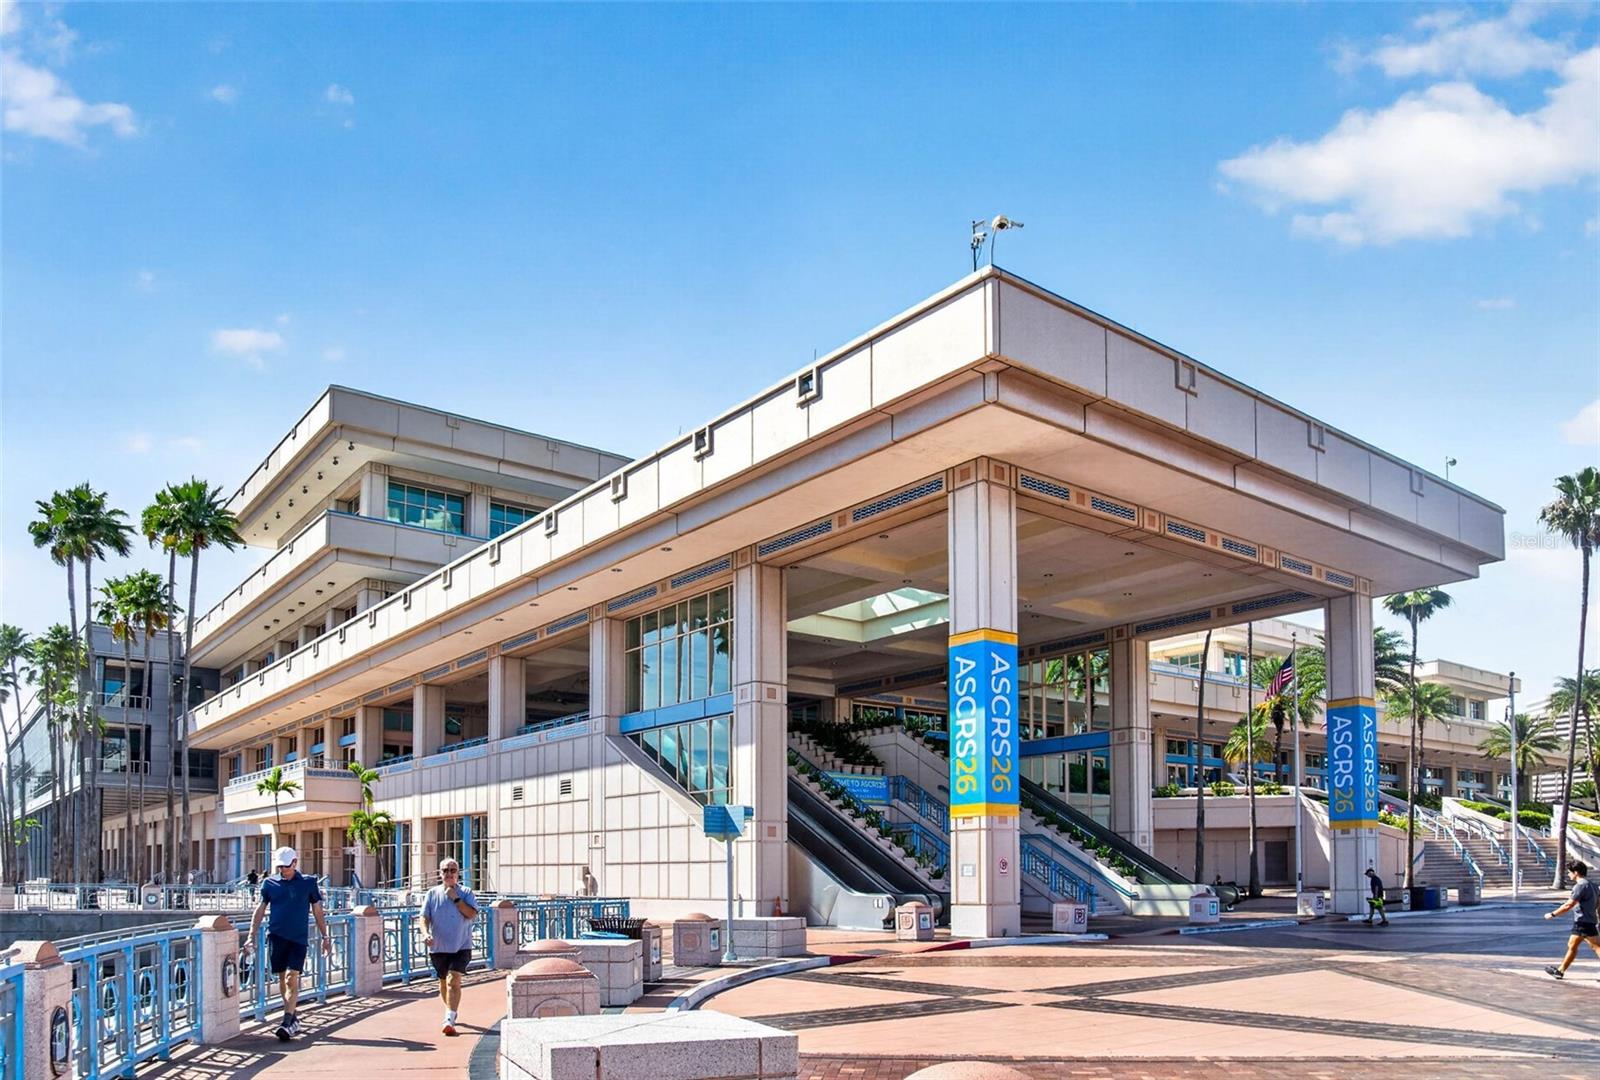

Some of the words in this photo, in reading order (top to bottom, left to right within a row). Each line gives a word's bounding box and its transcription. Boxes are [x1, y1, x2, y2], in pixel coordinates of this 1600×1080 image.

[955, 656, 978, 794] ASCRS26
[991, 651, 1012, 792] ASCRS26
[1332, 715, 1355, 813] ASCRS26
[1362, 713, 1375, 812] ASCRS26
